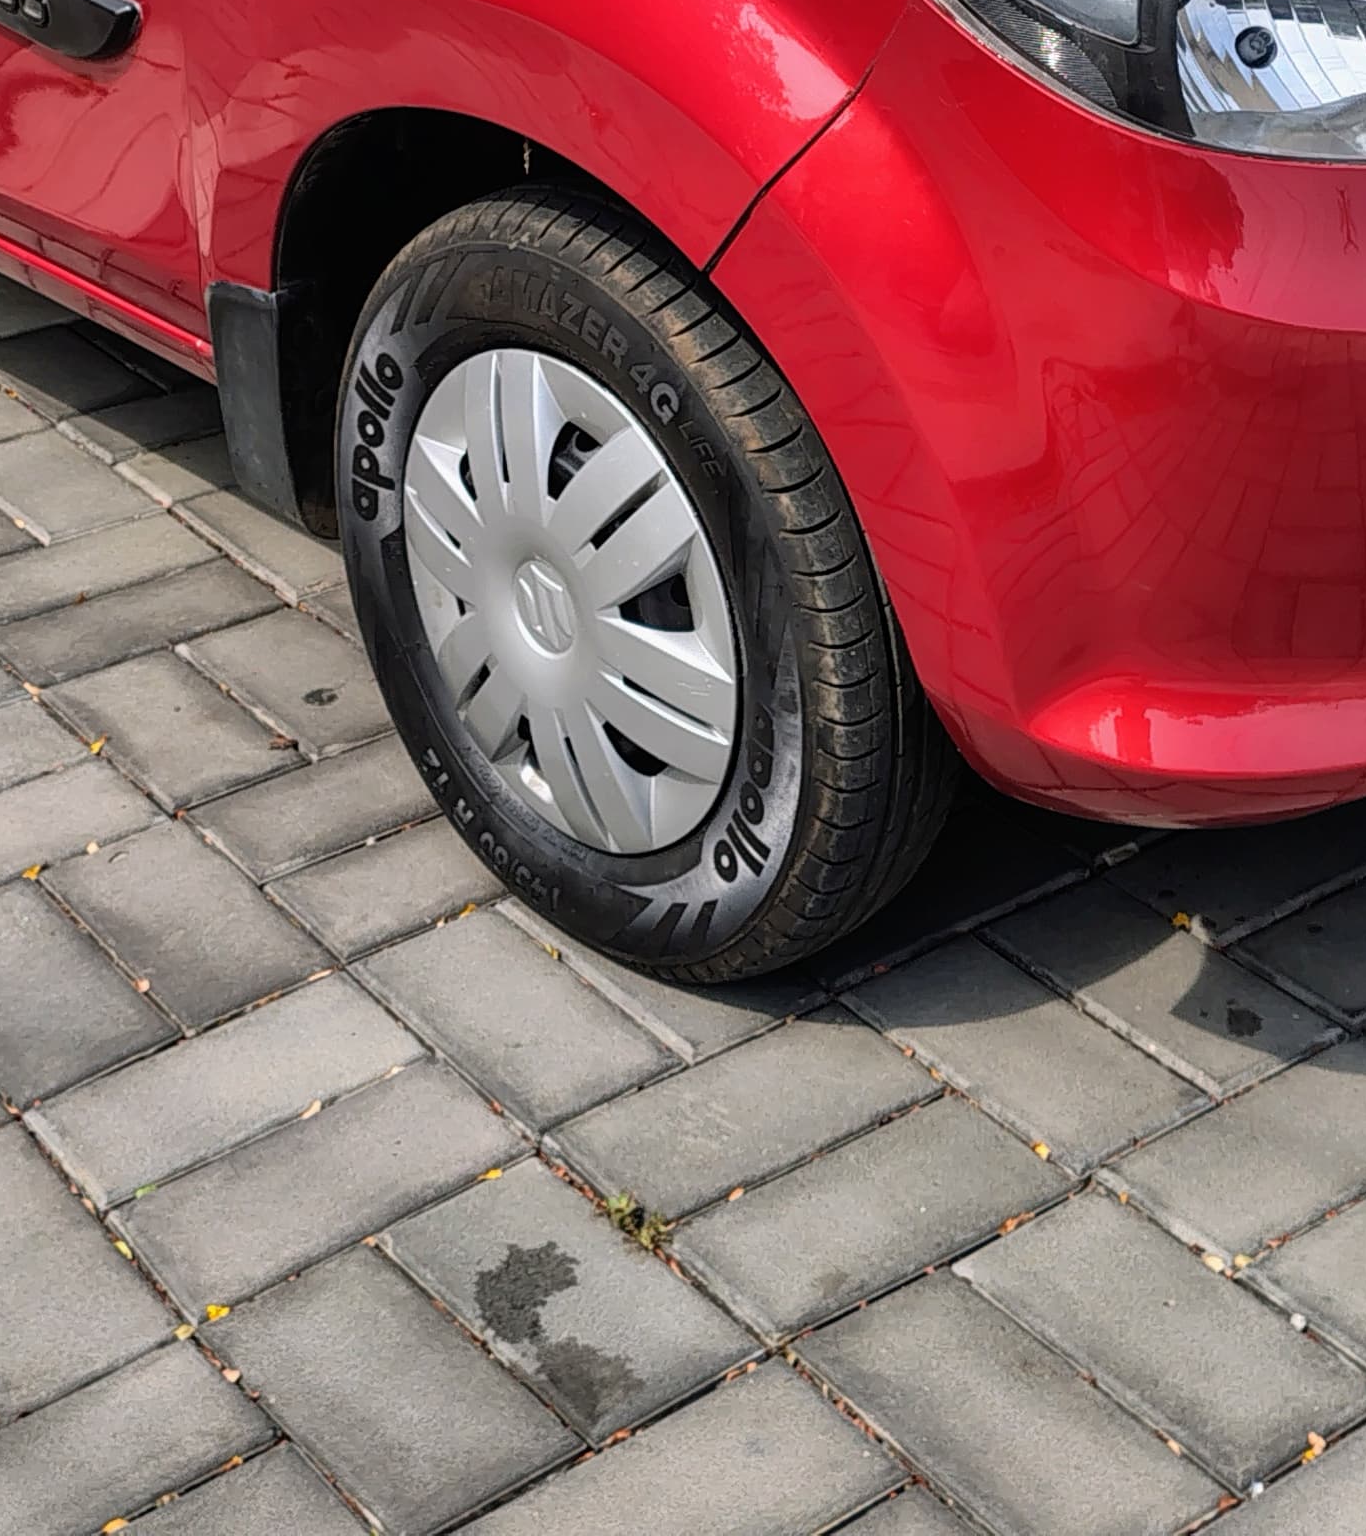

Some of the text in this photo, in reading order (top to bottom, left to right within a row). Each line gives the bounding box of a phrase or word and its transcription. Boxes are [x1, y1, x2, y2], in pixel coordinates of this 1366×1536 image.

[352, 352, 403, 522] apollo
[629, 364, 680, 426] 4G
[678, 420, 729, 481] LIFE
[713, 702, 775, 883] apollo
